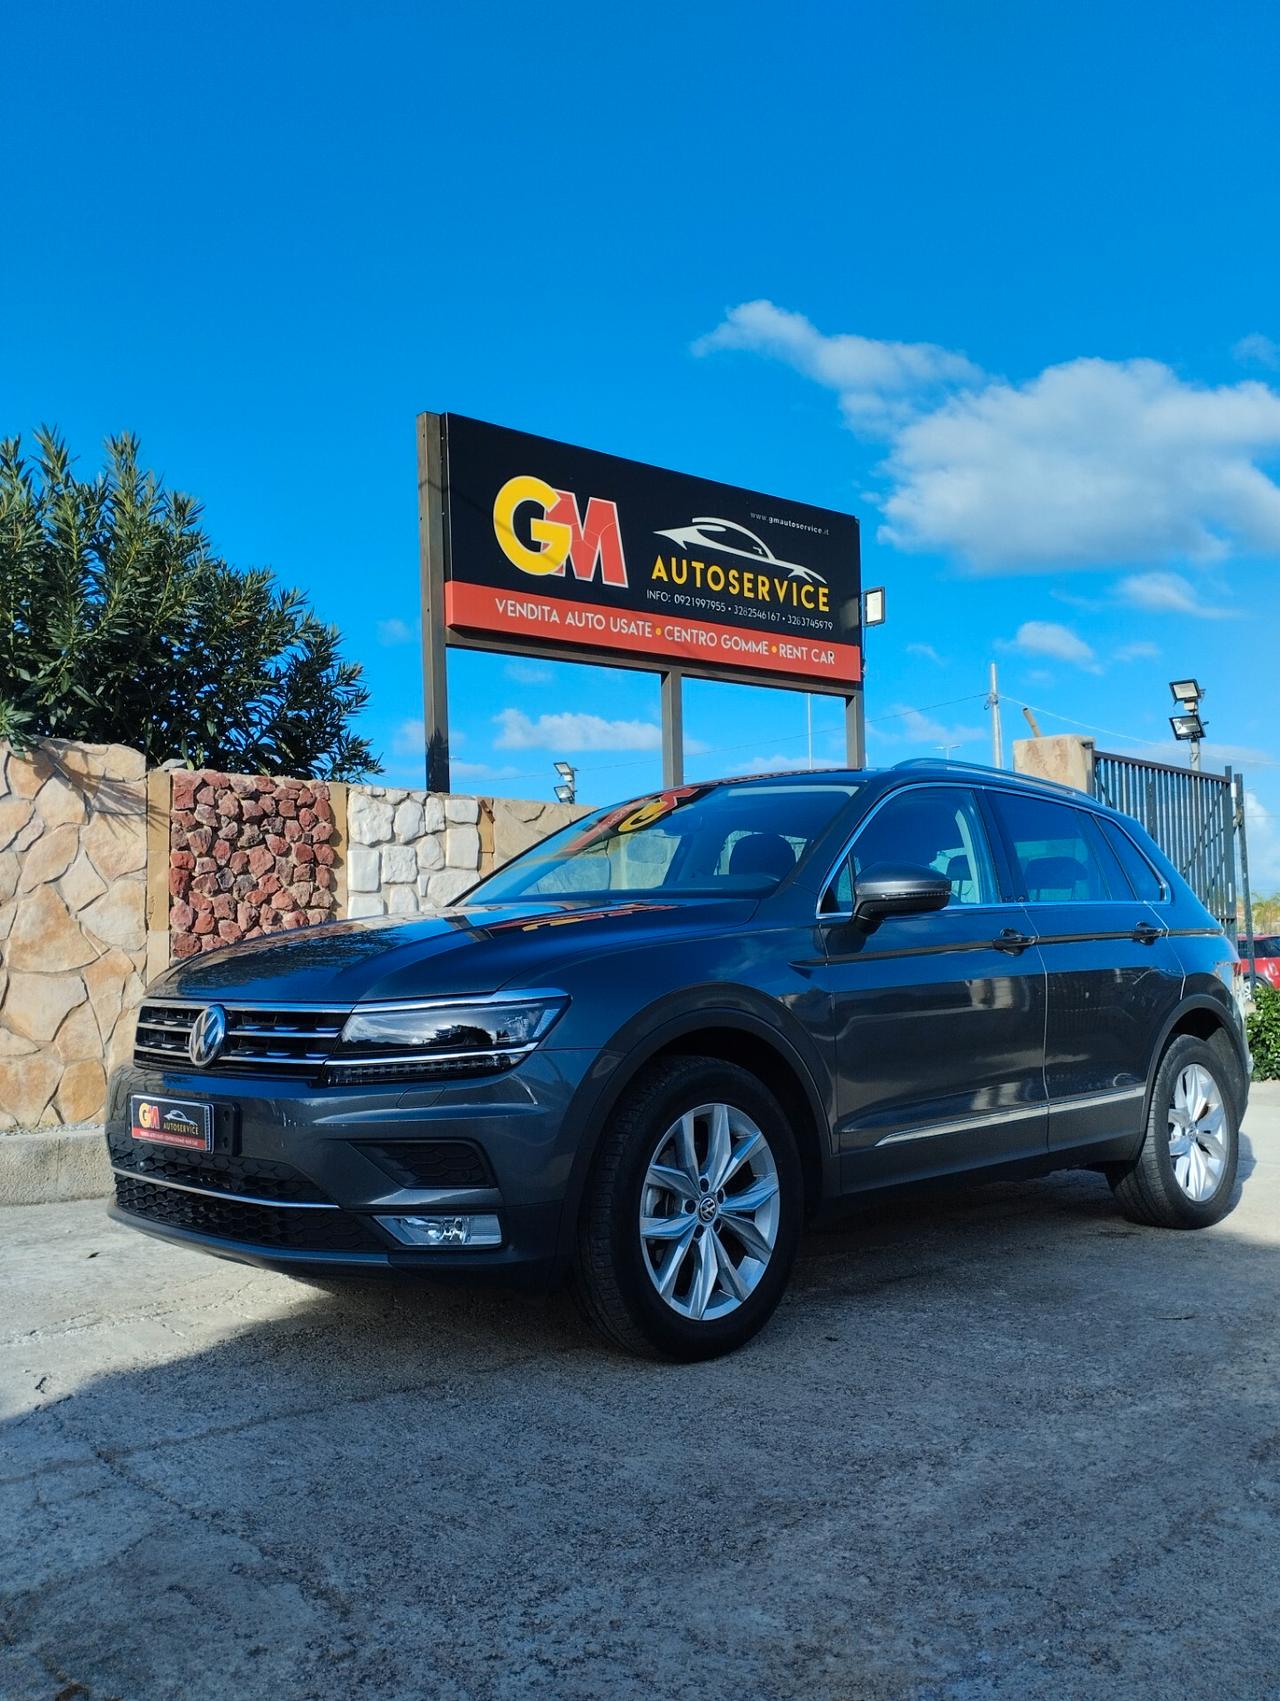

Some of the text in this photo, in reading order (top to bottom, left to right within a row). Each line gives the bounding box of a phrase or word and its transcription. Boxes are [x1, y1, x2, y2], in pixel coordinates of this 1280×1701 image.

[493, 475, 629, 588] GM
[646, 589, 671, 603] INFO:
[674, 594, 727, 613] 0921997955
[651, 554, 830, 612] AUTOSERVICE
[496, 598, 835, 665] VENDITA AUTO USATE CENTRO GOMME RENT CAR
[138, 1102, 160, 1129] GM
[163, 1120, 199, 1136] AUTOSERVICE
